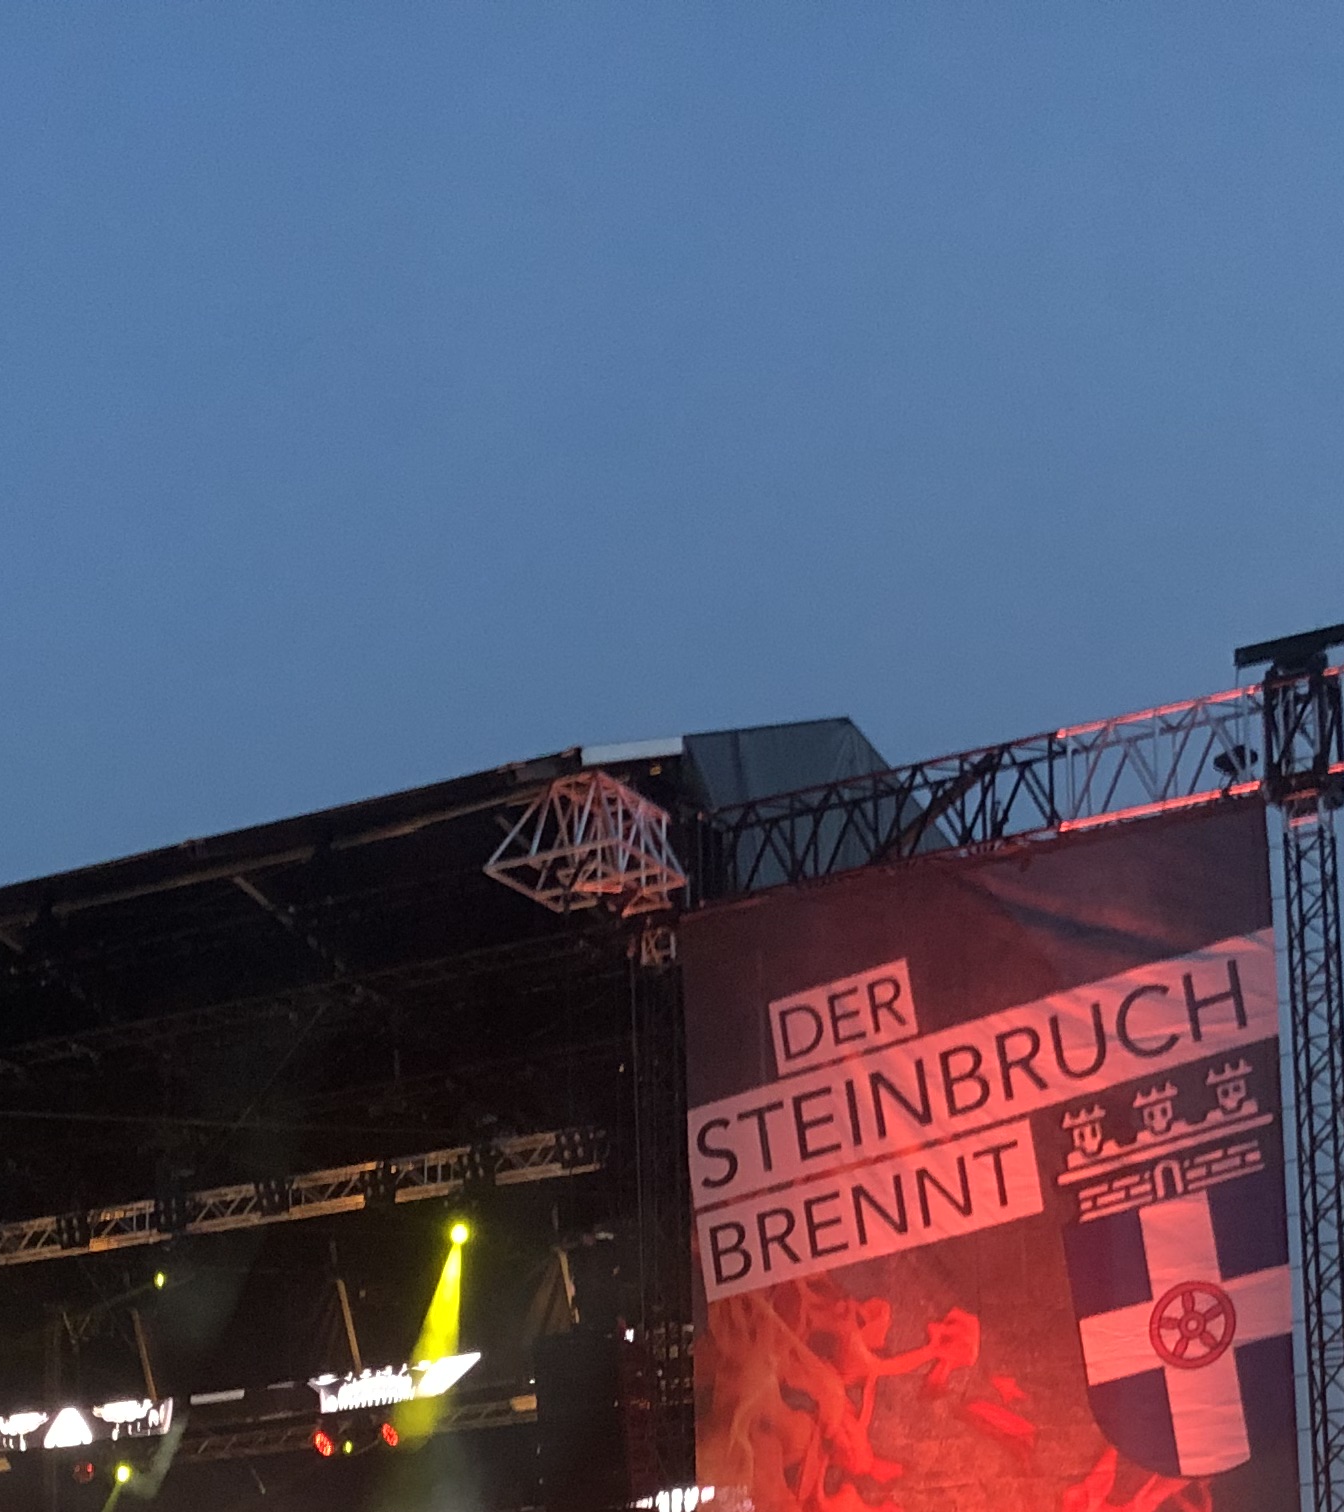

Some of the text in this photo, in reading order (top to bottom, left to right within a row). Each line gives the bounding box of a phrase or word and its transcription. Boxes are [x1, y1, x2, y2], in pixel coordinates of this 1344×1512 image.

[696, 958, 1250, 1190] STEINBRUCH
[778, 975, 906, 1063] DER
[709, 1140, 1020, 1286] BRENNT
